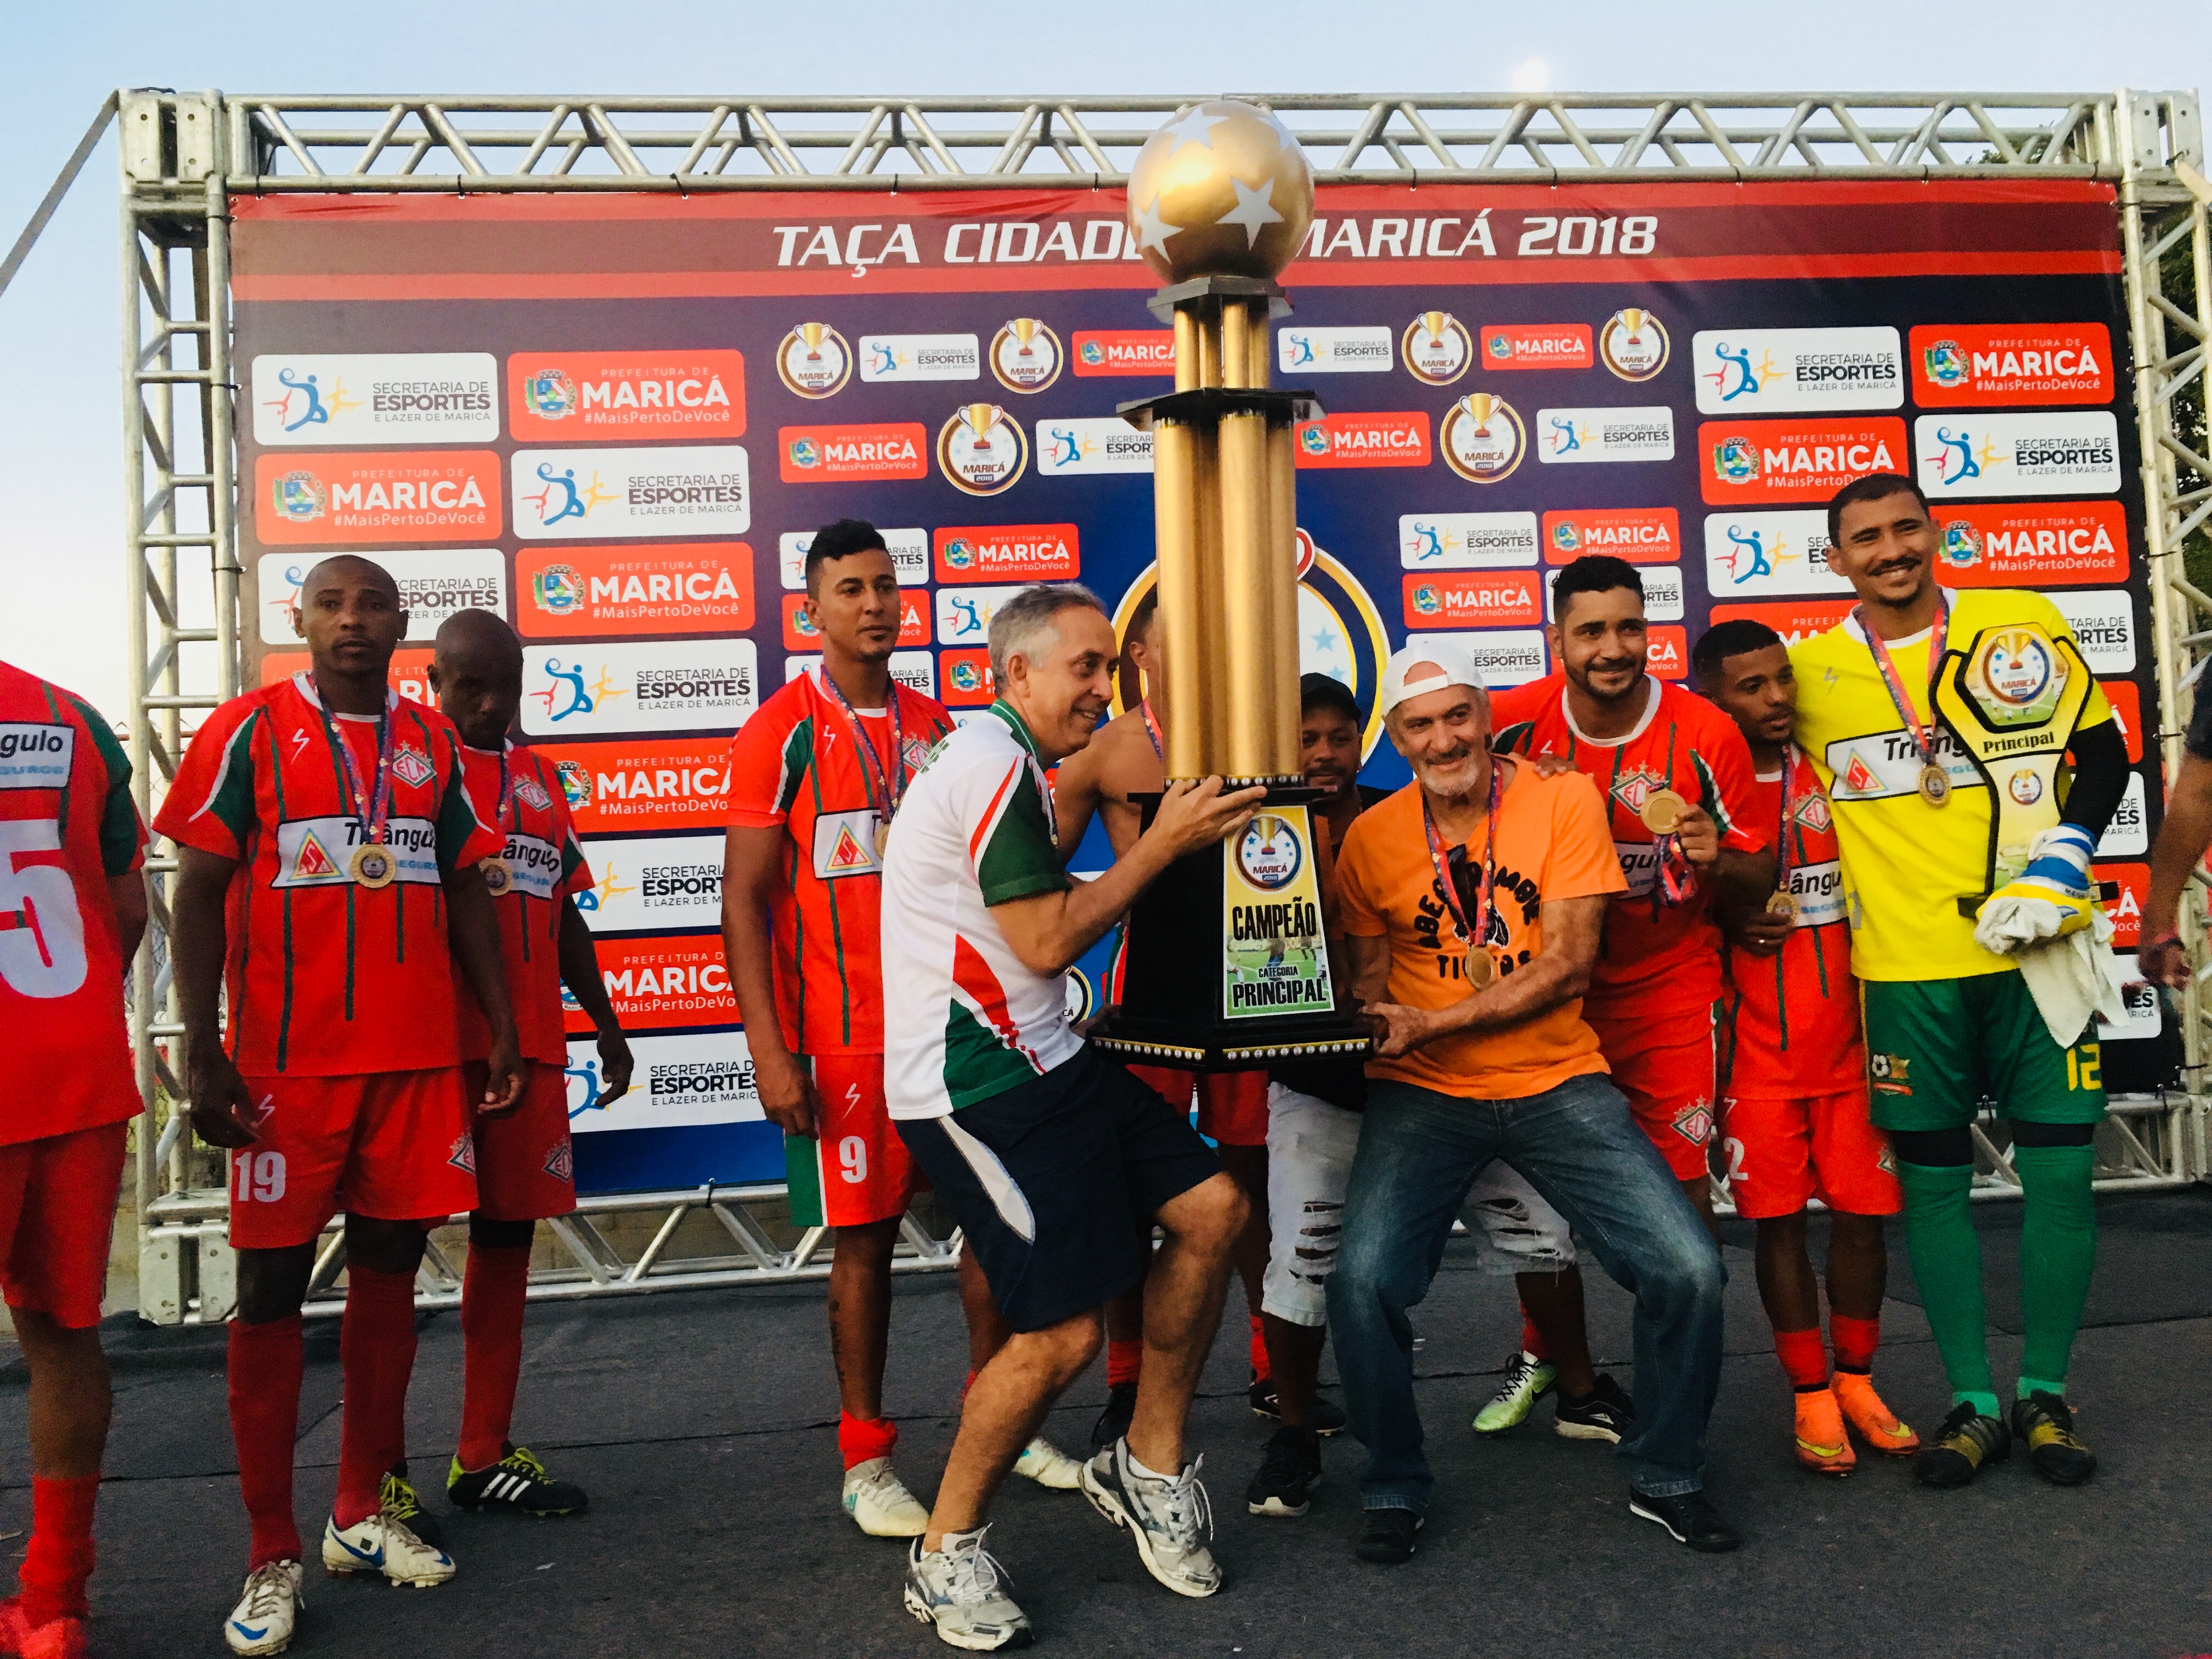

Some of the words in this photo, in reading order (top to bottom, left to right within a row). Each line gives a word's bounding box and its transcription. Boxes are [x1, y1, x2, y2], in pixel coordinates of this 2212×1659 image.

[772, 223, 920, 278] TAÇA
[1517, 216, 1658, 256] 2018
[1334, 347, 1389, 356] ESPORTES
[1515, 336, 1585, 353] MARICÁ
[918, 355, 975, 364] ESPORTES
[1422, 358, 1454, 367] MARICÁ
[1620, 354, 1652, 364] MARICÁ
[1796, 354, 1873, 365] SECRETARIA
[1877, 353, 1893, 363] DE
[1973, 346, 2100, 377] MARICÁ
[602, 368, 685, 377] PREFEITURA
[798, 370, 833, 380] MARICÁ
[1011, 366, 1045, 376] MARICÁ
[1796, 364, 1896, 381] ESPORTES
[373, 382, 464, 393] SECRETARIA
[470, 382, 488, 392] DE
[582, 375, 730, 409] MARICÁ
[1807, 383, 1837, 391] LAZER
[1858, 380, 1896, 390] MARICÁ
[1977, 379, 2100, 391] #MaisPertoDeVocê
[374, 394, 490, 411] ESPORTES
[386, 413, 421, 422] LAZER
[426, 413, 440, 421] DE
[445, 411, 490, 421] MARICÁ
[585, 410, 730, 424] #MaisPertoDeVocê
[1334, 427, 1421, 448] MARICÁ
[1604, 431, 1669, 442] ESPORTES
[1781, 434, 1854, 443] PREFEITURA
[2015, 438, 2091, 449] SECRETARIA
[2095, 438, 2111, 448] DE
[825, 439, 917, 461] MARICÁ
[1464, 449, 1504, 461] MARICÁ
[1764, 440, 1894, 473] MARICÁ
[2016, 449, 2113, 466] ESPORTES
[353, 469, 439, 478] PREFEITURA
[447, 469, 464, 477] DE
[963, 461, 1005, 473] MARICÁ
[2027, 467, 2056, 475] LAZER
[2075, 464, 2113, 474] MARICÁ
[629, 475, 716, 487] SECRETARIA
[721, 474, 740, 485] DE
[332, 476, 486, 511] MARICÁ
[629, 486, 742, 505] ESPORTES
[641, 506, 675, 515] LAZER
[698, 503, 742, 514] MARICÁ
[335, 512, 486, 526] #MaisPertoDeVocê
[2003, 518, 2074, 527] PREFEITURA
[1585, 523, 1670, 544] MARICÁ
[1987, 524, 2115, 557] MARICÁ
[1467, 537, 1533, 548] ESPORTES
[979, 539, 1069, 562] MARICÁ
[610, 562, 693, 571] PREFEITURA
[702, 561, 718, 569] DE
[1990, 557, 2115, 571] #MaisPertoDeVocê
[477, 578, 496, 589] DE
[591, 568, 739, 603] MARICÁ
[399, 590, 498, 608] SPORTES
[1446, 586, 1532, 608] MARICÁ
[594, 603, 738, 618] #MaisPertoDeVocê
[2109, 616, 2125, 627] DE
[2092, 645, 2128, 653] MARICÁ
[1474, 655, 1541, 667] ESPORTES
[637, 668, 725, 681] SECRETARIA
[730, 668, 748, 679] DE
[637, 680, 751, 699] ESPORTES
[649, 700, 684, 709] LAZER
[688, 699, 702, 708] DE
[706, 696, 751, 707] MARICÁ
[1983, 732, 2055, 753] Principal
[617, 757, 704, 767] PREFEITURA
[708, 755, 725, 764] DE
[600, 800, 727, 815] #MaisPertoDeVo
[642, 865, 724, 879] SECRETARI
[1253, 861, 1288, 874] MARICÁ
[642, 877, 723, 896] ESPOR
[654, 897, 690, 906] LAZER
[694, 896, 708, 905] DE
[0, 819, 87, 998] 5
[1232, 896, 1316, 941] CAMPEÃO
[624, 953, 708, 964] PREFEITURA
[1259, 966, 1299, 978] CATEGORIA
[603, 964, 733, 998] MARIC
[1232, 978, 1327, 1008] PRINCIPAL
[651, 1062, 738, 1077] SECRETARIA
[2067, 1043, 2102, 1091] 12
[662, 1096, 697, 1105] LAZER
[702, 1094, 716, 1103] DE
[721, 1091, 759, 1101] MARIC
[839, 1136, 867, 1183] 9
[235, 1152, 286, 1202] 19
